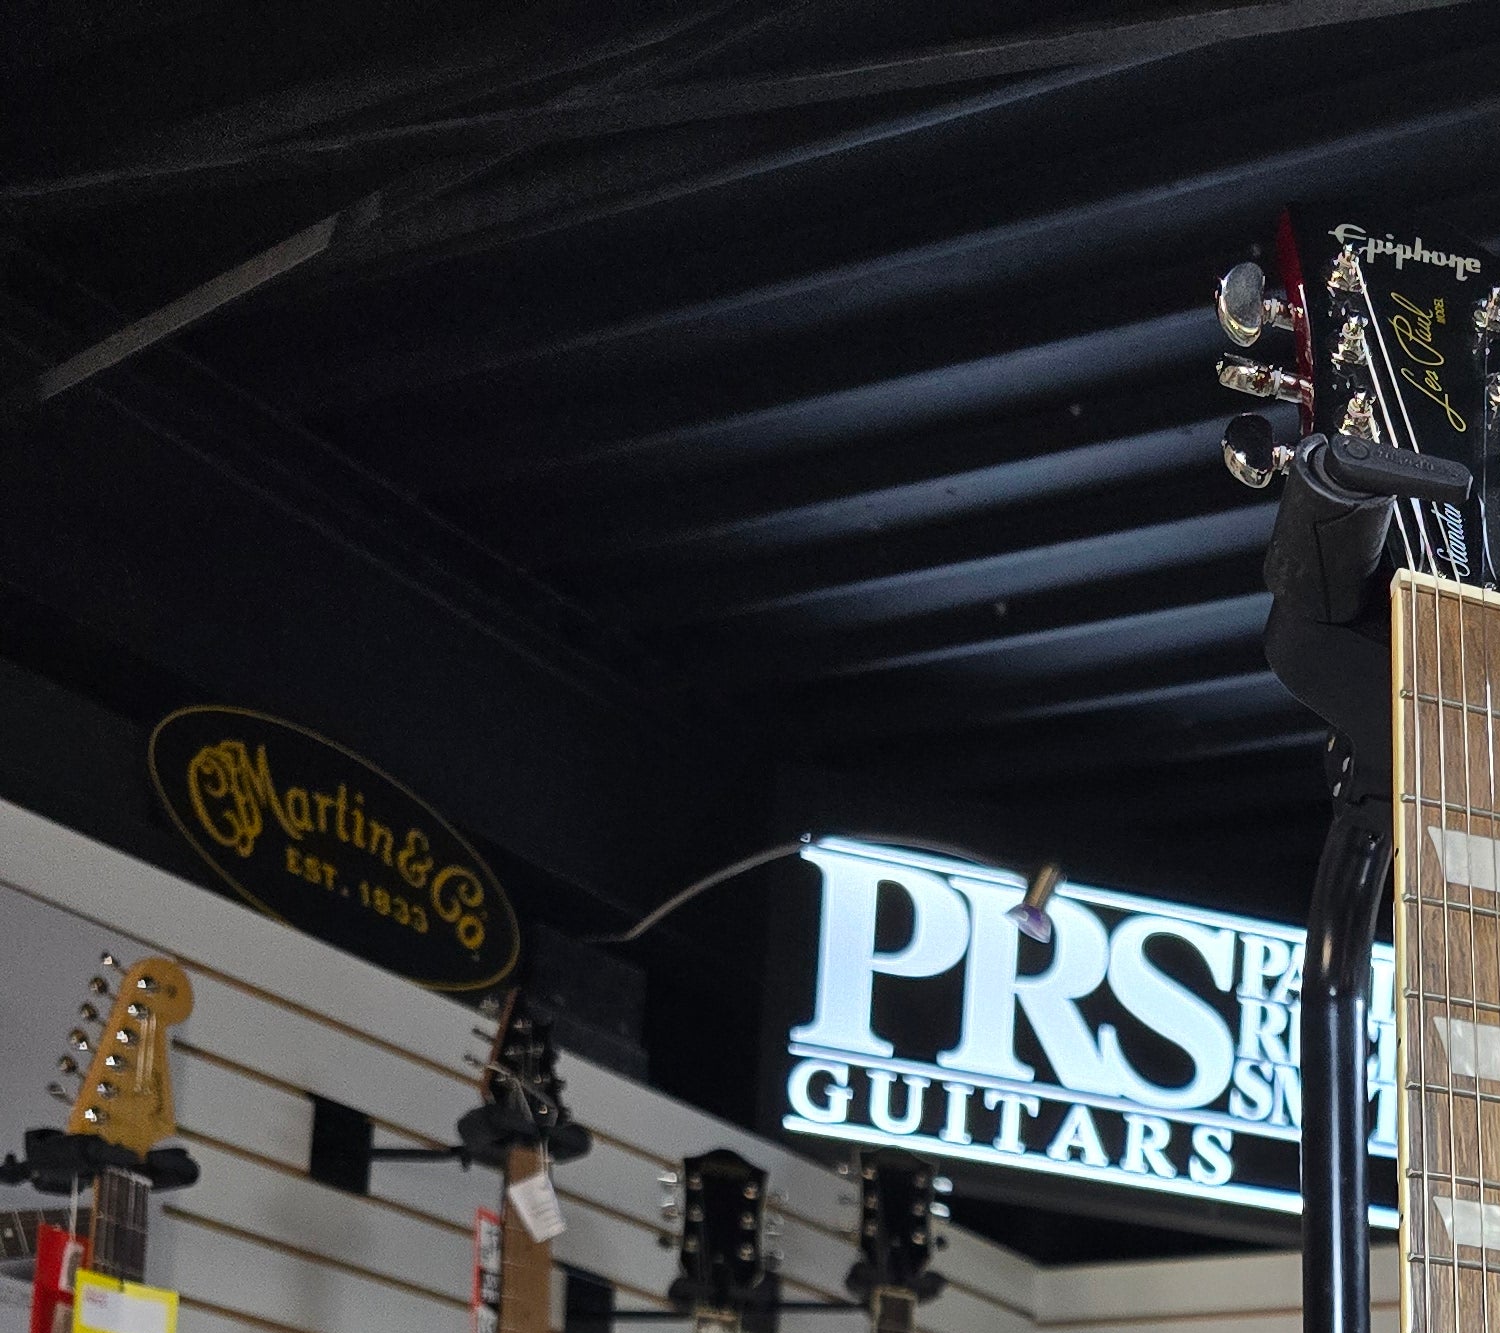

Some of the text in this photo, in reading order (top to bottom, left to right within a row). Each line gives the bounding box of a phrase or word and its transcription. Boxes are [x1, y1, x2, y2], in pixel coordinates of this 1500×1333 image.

[1327, 223, 1482, 282] Epiphone
[1387, 291, 1445, 366] Paul
[1401, 367, 1467, 432] Les
[359, 880, 429, 934] 1833
[790, 849, 1241, 1111] PRS
[787, 1059, 1236, 1187] GUITARS
